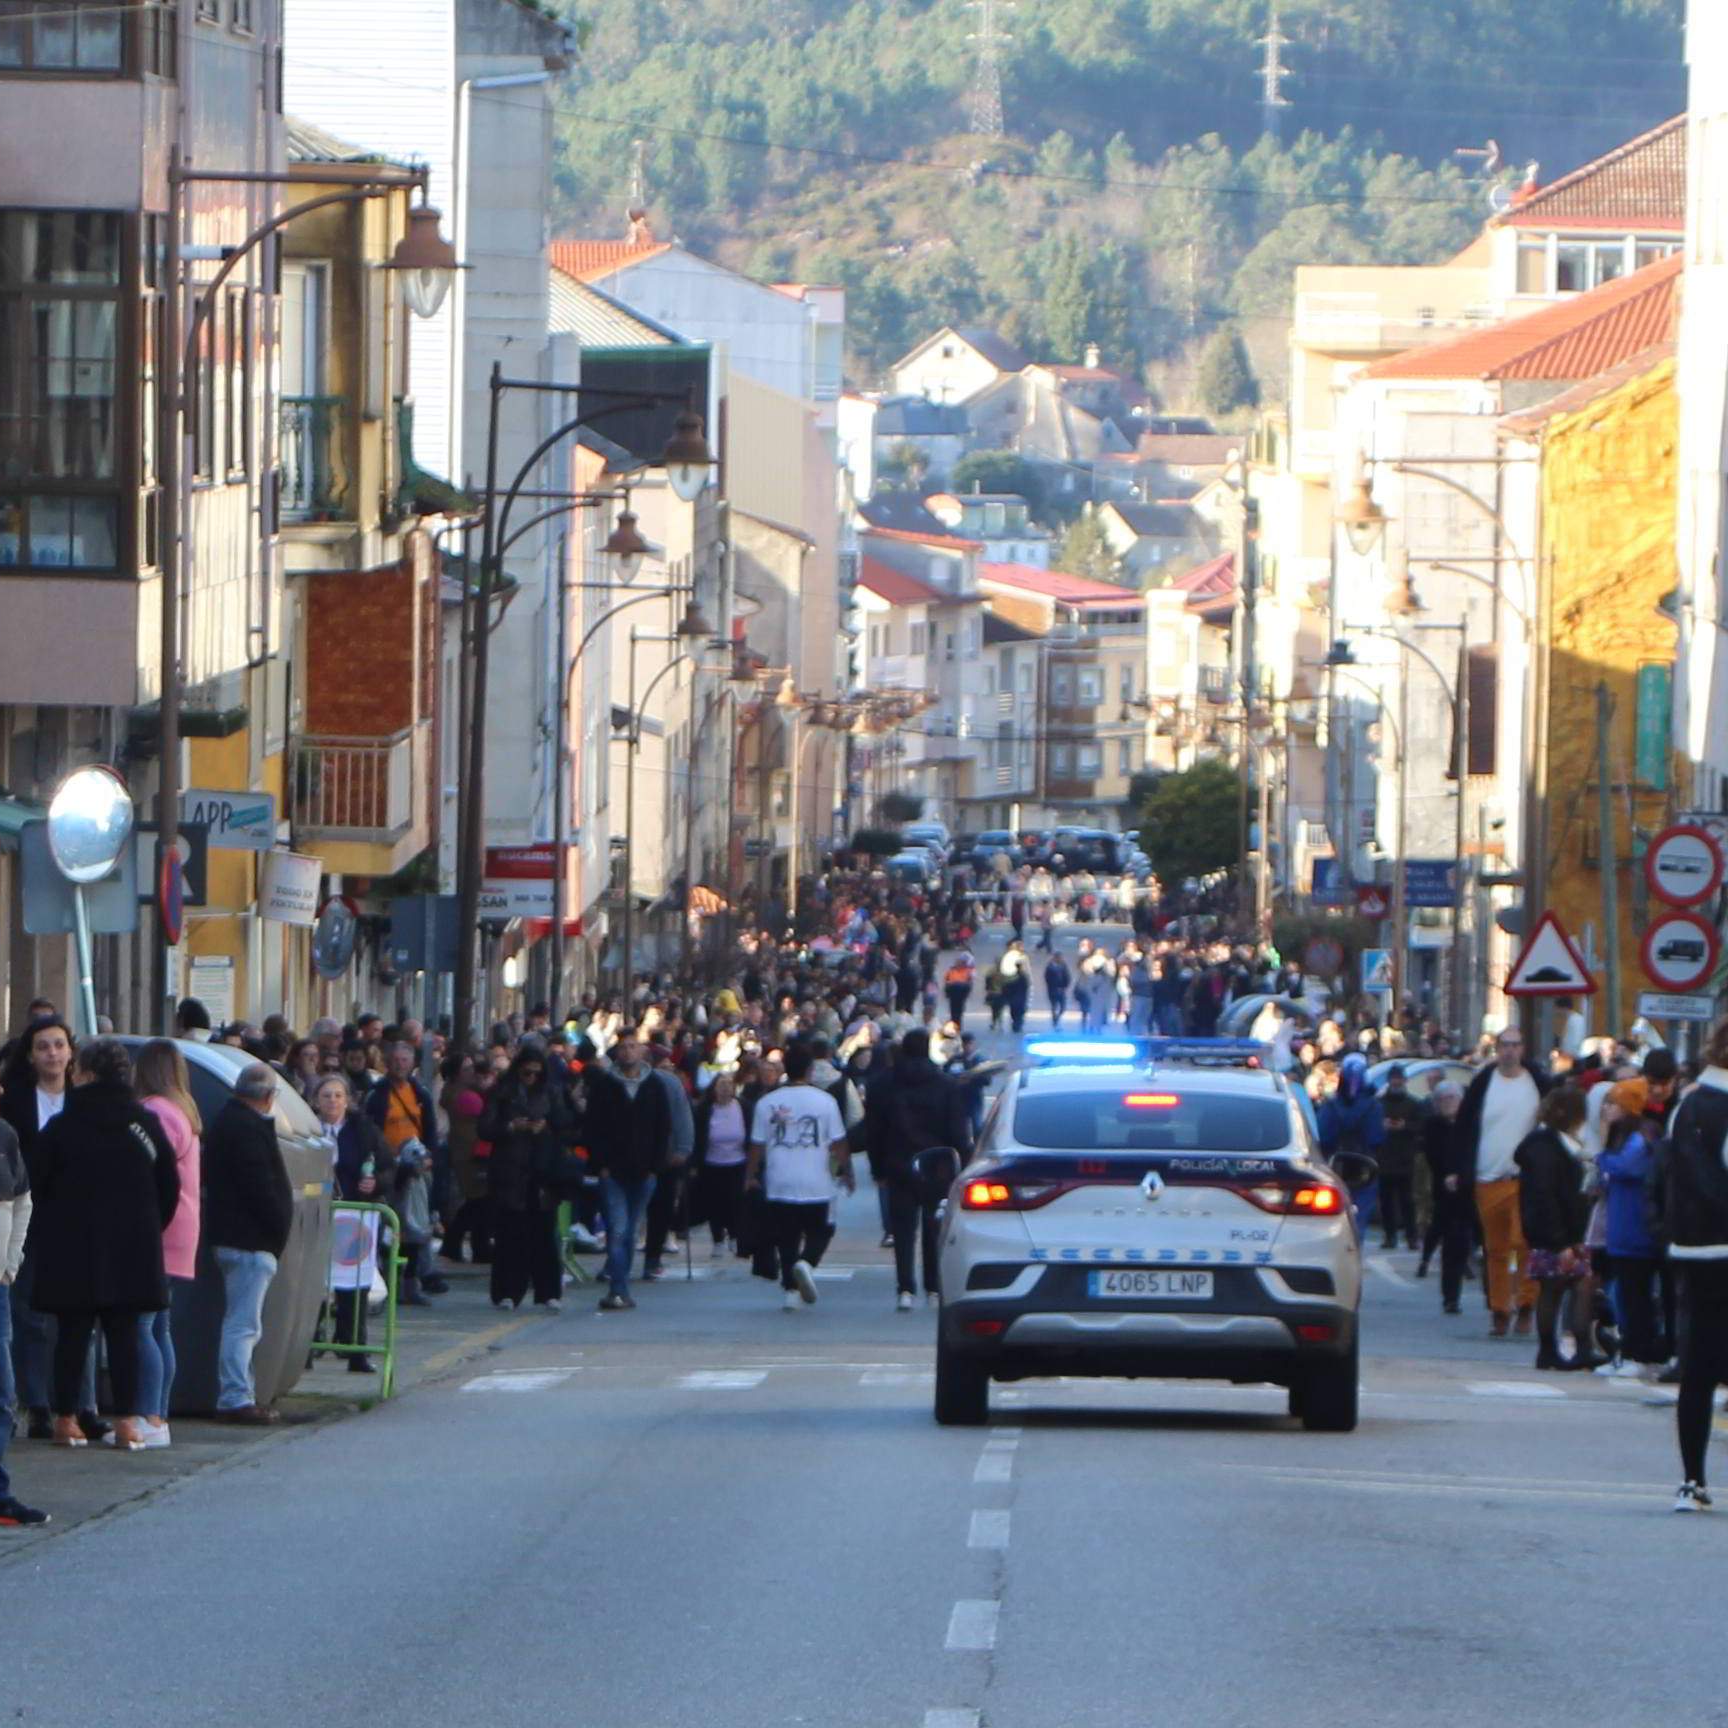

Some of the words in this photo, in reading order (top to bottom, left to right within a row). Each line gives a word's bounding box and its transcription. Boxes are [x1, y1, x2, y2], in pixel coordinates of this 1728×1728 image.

[1234, 1159, 1276, 1172] LOCAL
[1105, 1272, 1160, 1294] 4065
[1166, 1273, 1209, 1294] LNP
